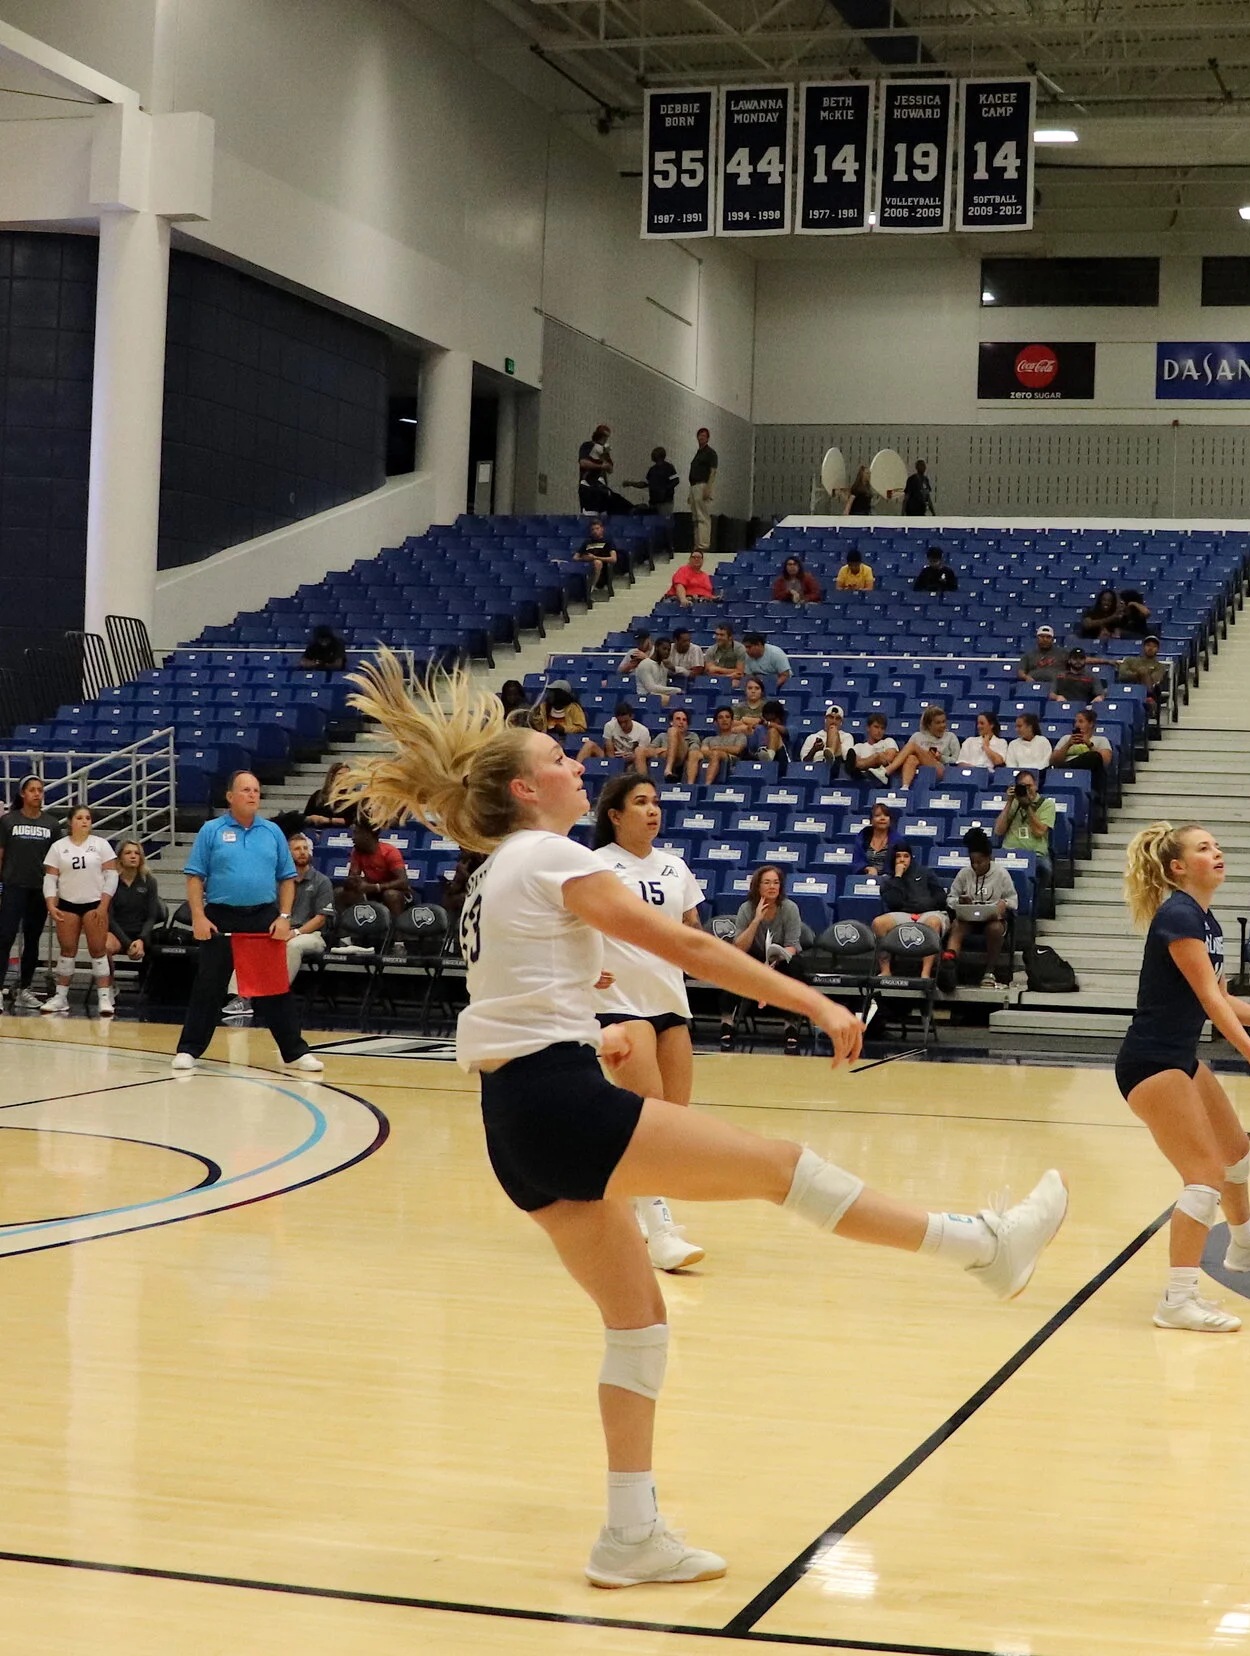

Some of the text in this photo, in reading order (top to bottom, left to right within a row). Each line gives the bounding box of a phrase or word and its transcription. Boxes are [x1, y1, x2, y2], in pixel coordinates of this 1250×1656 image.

[823, 96, 853, 107] BETH
[894, 95, 941, 106] JESSICA
[979, 93, 1017, 104] KACEE
[660, 103, 700, 115] DEBBIE
[731, 100, 783, 111] LAWANNA
[820, 109, 854, 120] McKIE
[894, 108, 940, 119] HOWARD
[981, 106, 1014, 117] CAMP
[665, 116, 695, 127] BORN
[734, 112, 780, 123] MONDAY
[813, 144, 859, 183] 14
[893, 142, 939, 182] 19
[973, 140, 1021, 180] 14
[653, 150, 704, 188] 55
[726, 146, 784, 186] 44
[885, 195, 941, 206] VOLLEYBALL
[973, 194, 1017, 204] SOFTBALL
[1000, 205, 1022, 216] 2012
[1010, 391, 1033, 399] zero
[12, 825, 51, 839] AUGUSTA
[72, 856, 86, 870] 21
[638, 881, 665, 906] 15
